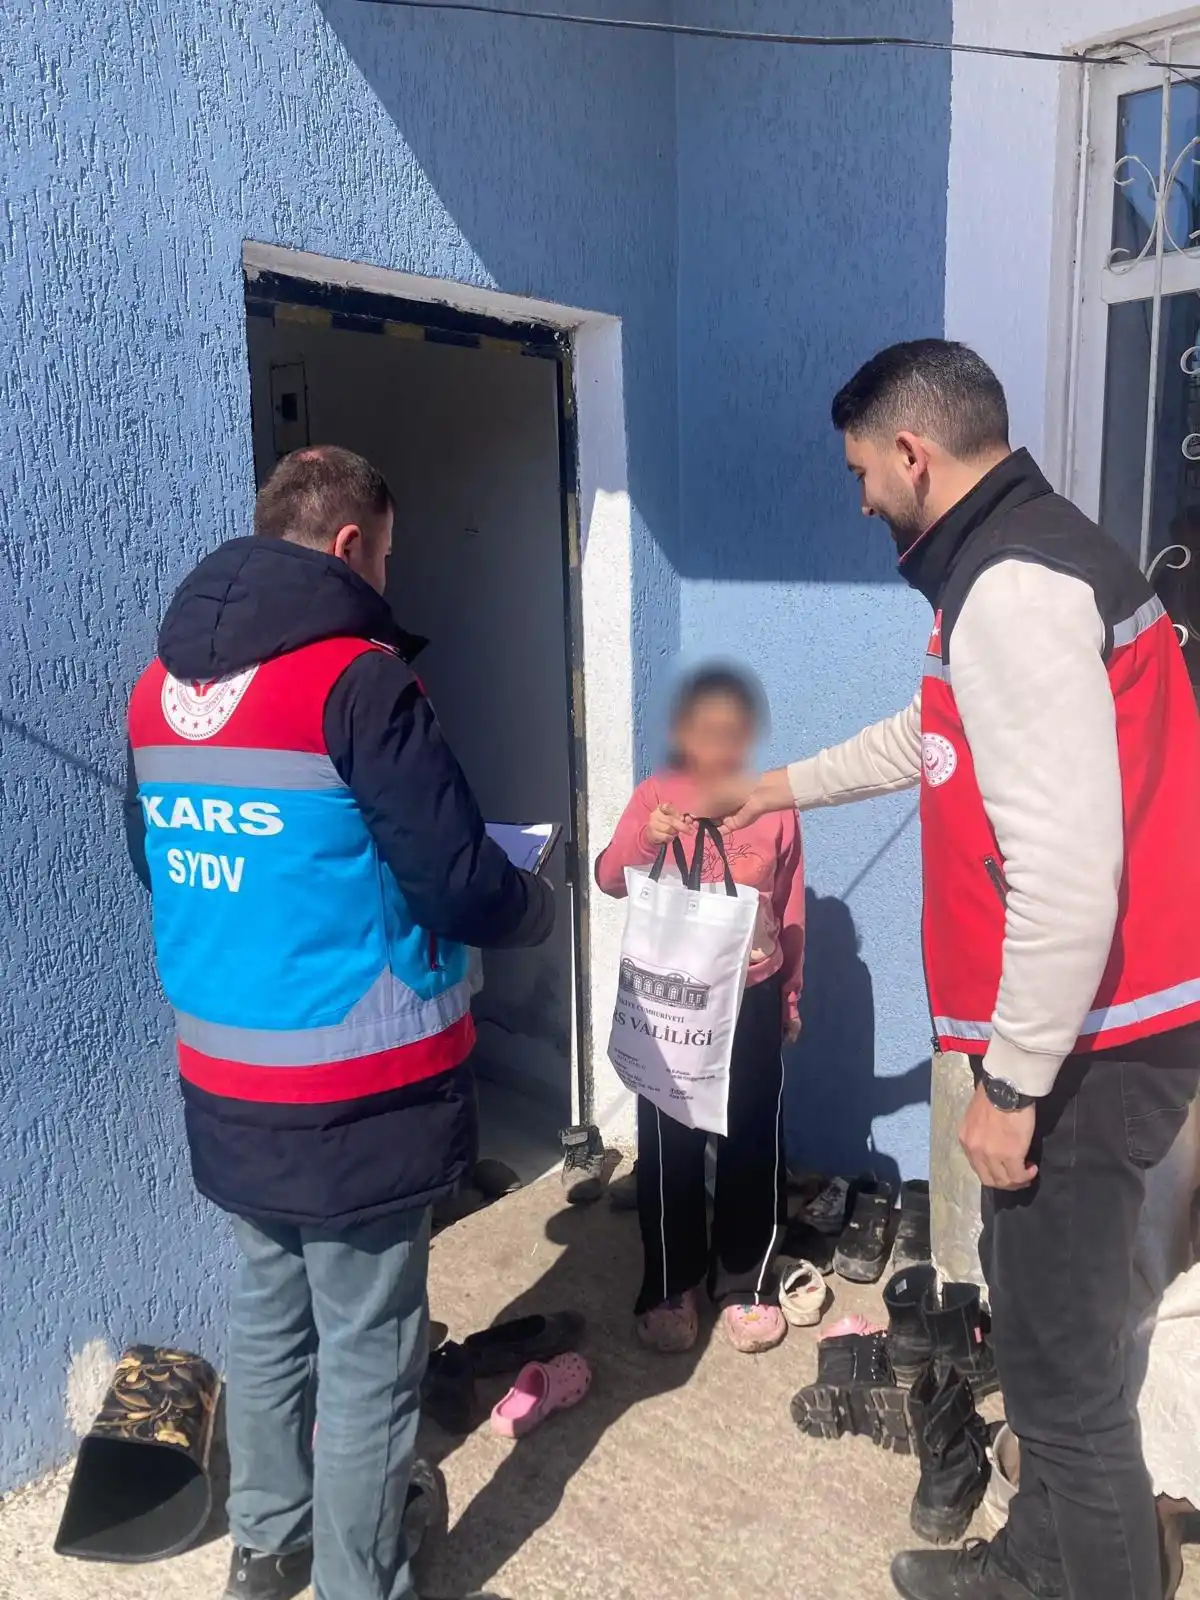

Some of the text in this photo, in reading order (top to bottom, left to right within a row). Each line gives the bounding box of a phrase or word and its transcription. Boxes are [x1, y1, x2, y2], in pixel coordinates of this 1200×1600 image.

[141, 796, 285, 836] KARS
[167, 848, 245, 893] SYDV
[630, 1016, 713, 1046] VALİLİĞİ
